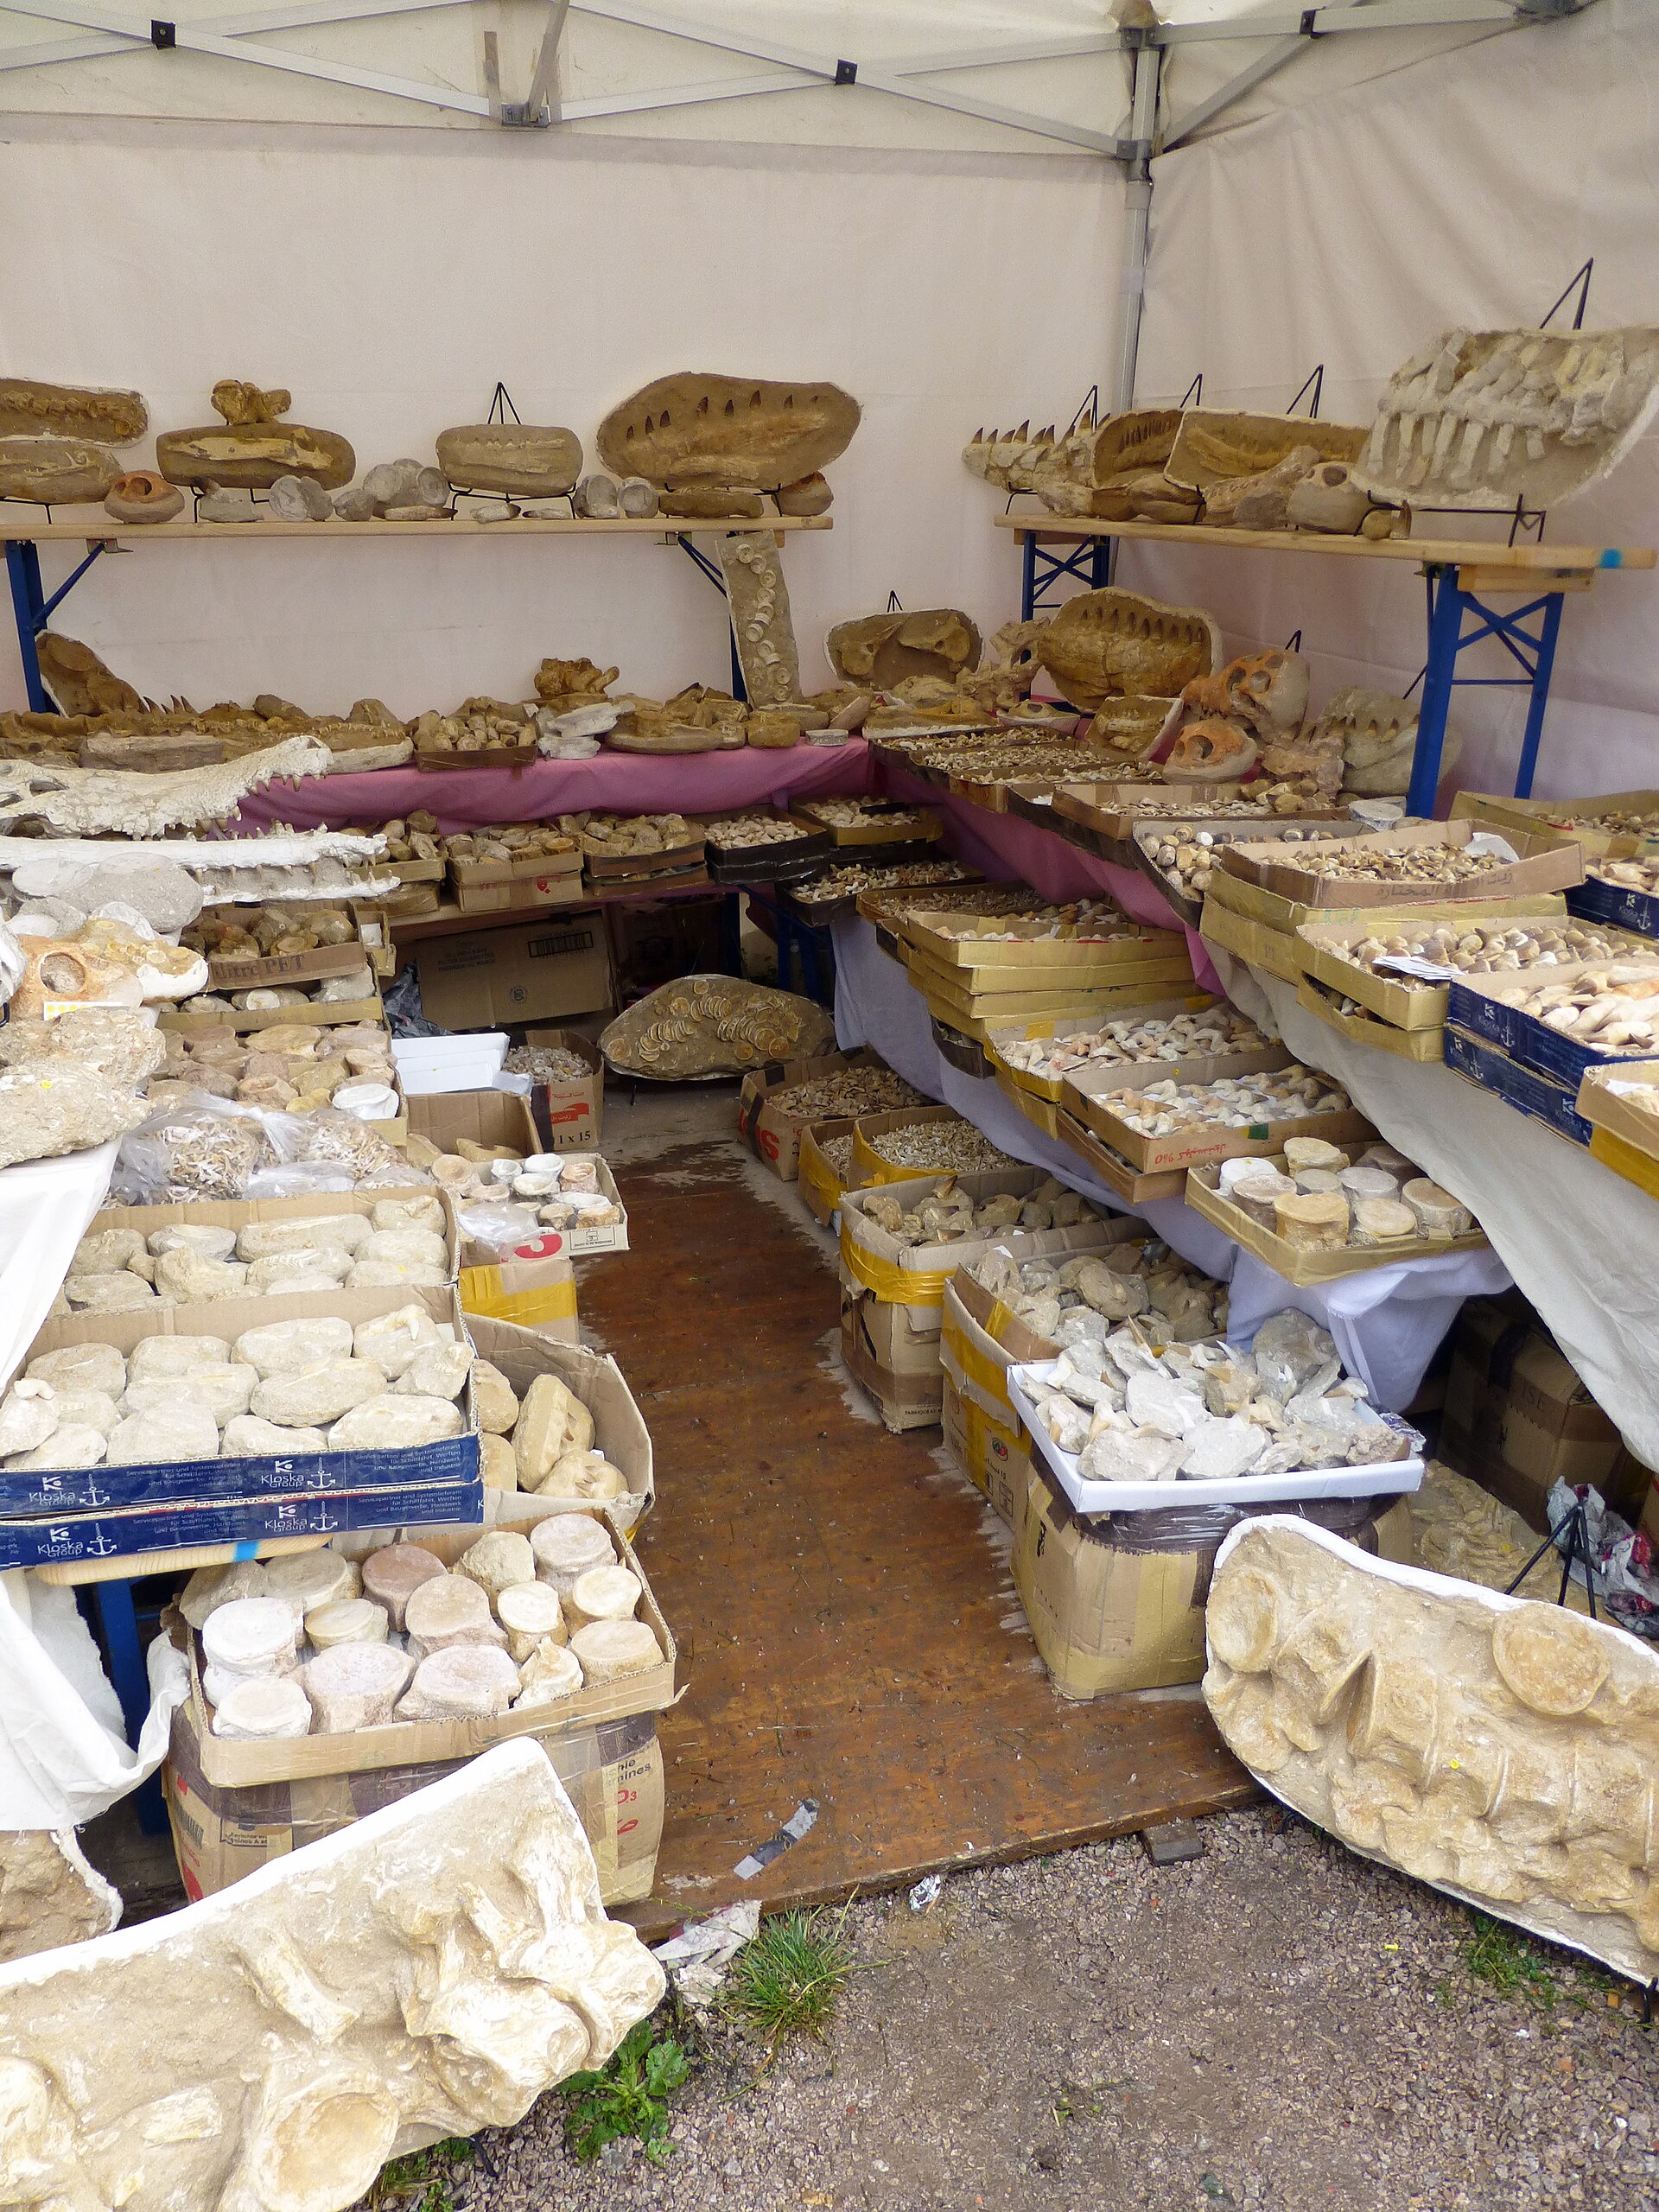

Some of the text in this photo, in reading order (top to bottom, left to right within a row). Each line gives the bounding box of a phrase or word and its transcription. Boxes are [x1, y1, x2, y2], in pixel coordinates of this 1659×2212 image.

[579, 1130, 591, 1141] 15
[261, 1472, 304, 1484] Kloska
[29, 1491, 75, 1503] Kloska
[264, 1517, 308, 1529] Kloska
[274, 1524, 306, 1533] Group
[37, 1541, 84, 1554] Kloska
[48, 1548, 82, 1557] Group
